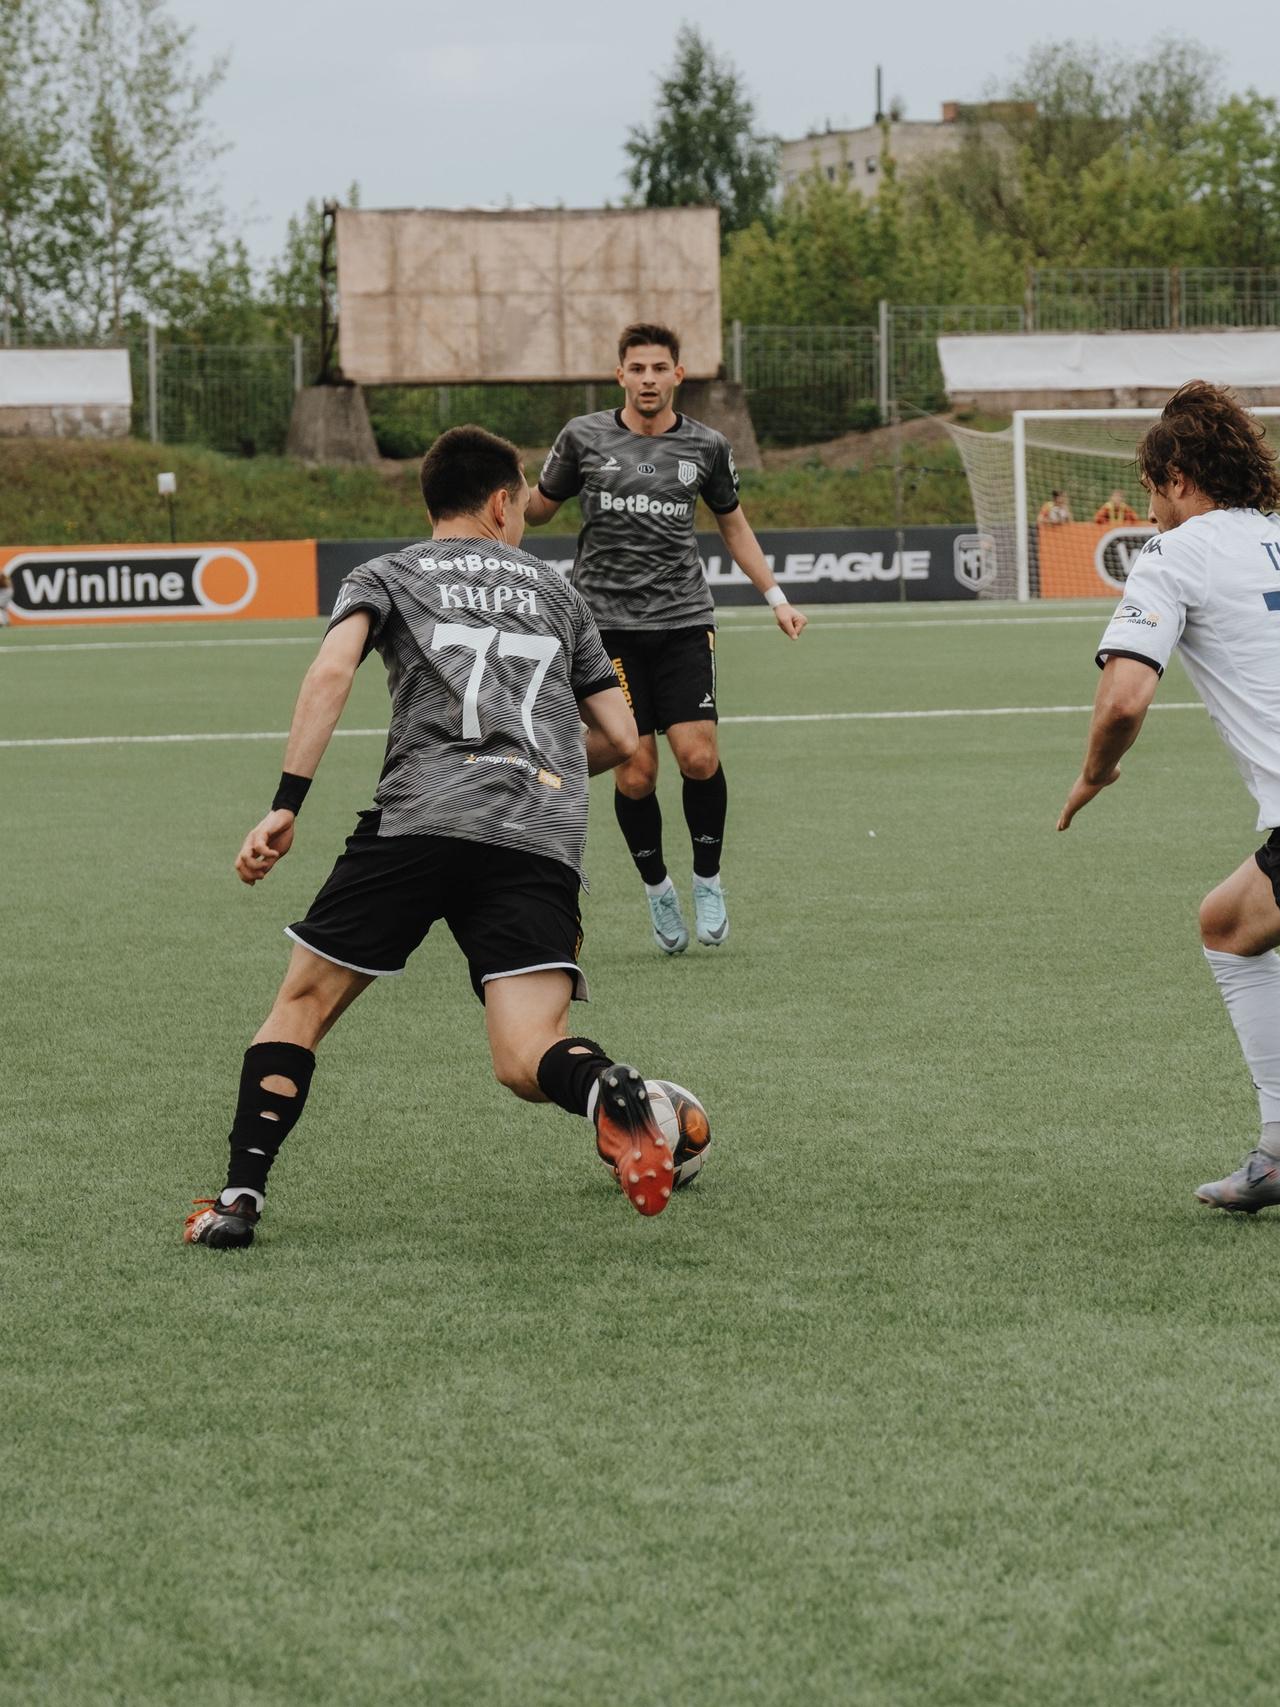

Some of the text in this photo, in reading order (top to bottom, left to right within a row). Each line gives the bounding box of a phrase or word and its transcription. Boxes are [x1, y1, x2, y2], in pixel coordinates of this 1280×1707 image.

[600, 491, 689, 516] BetBoom
[418, 554, 539, 579] BetBoom
[22, 565, 184, 604] Winline
[436, 583, 539, 615] КИРЯ
[431, 623, 561, 749] 77
